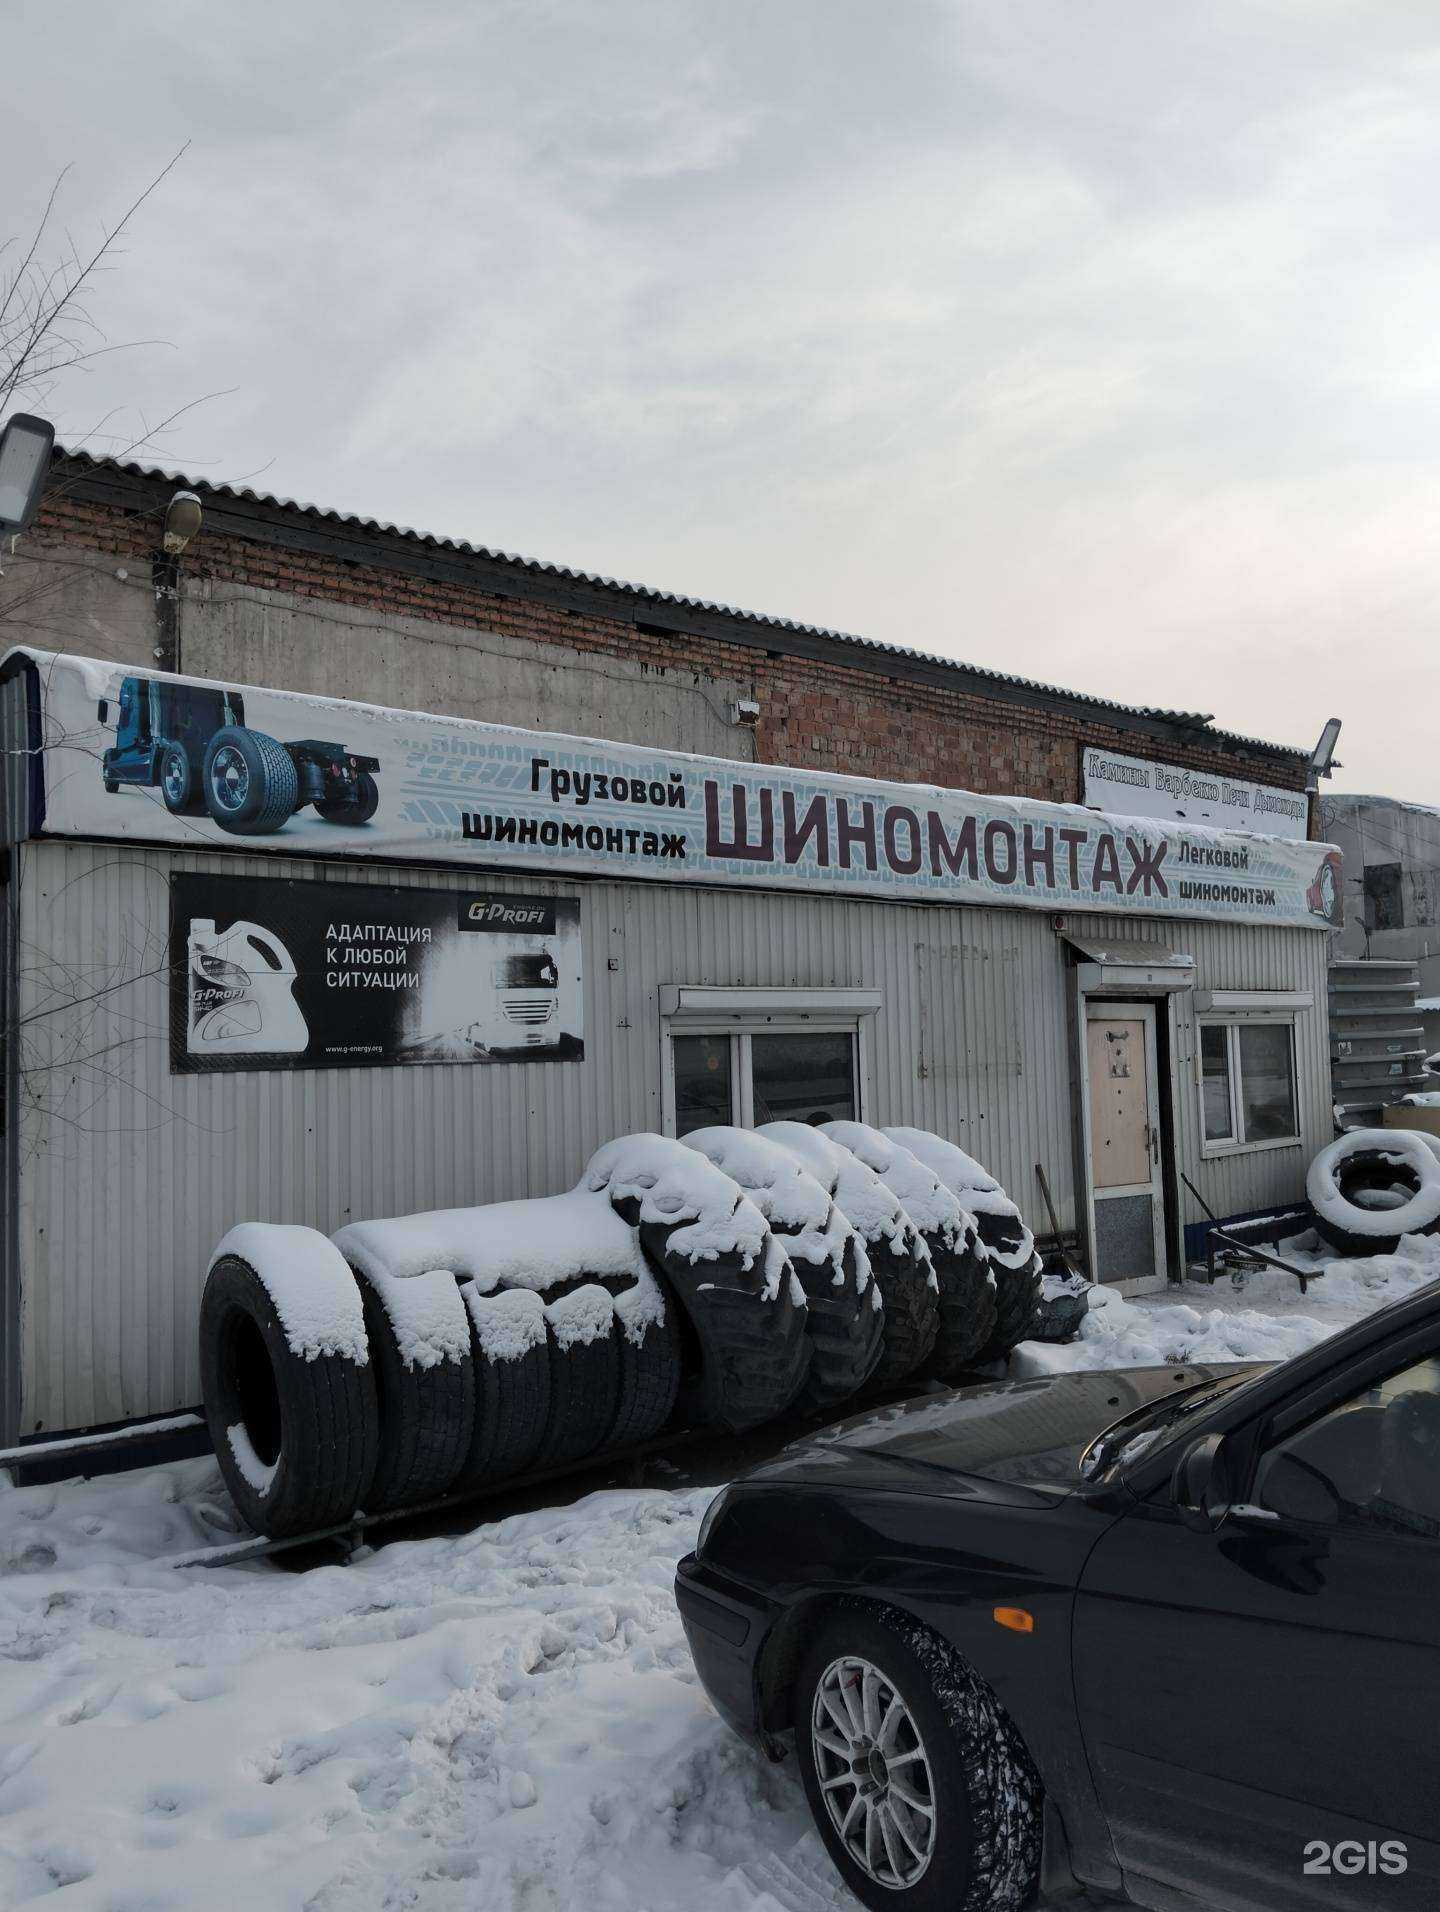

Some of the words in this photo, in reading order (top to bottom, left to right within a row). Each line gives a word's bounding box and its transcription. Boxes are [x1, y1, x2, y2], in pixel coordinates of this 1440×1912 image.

[531, 758, 686, 808] Грузовой
[1088, 754, 1150, 788] Камины
[1155, 768, 1220, 801] Барбекю
[1222, 783, 1250, 809] Печи
[462, 812, 686, 858] шиномонтаж
[704, 780, 1168, 898] ШИНОМОНТАЖ
[1178, 840, 1248, 870] Легковой
[1179, 881, 1276, 906] шиномонтаж
[326, 924, 432, 944] АДАПТАЦИЯ
[326, 947, 338, 963] К
[343, 946, 407, 964] ЛЮБОЙ
[326, 971, 419, 991] СИТУАЦИИ
[325, 1045, 383, 1054] www.g-energy.org
